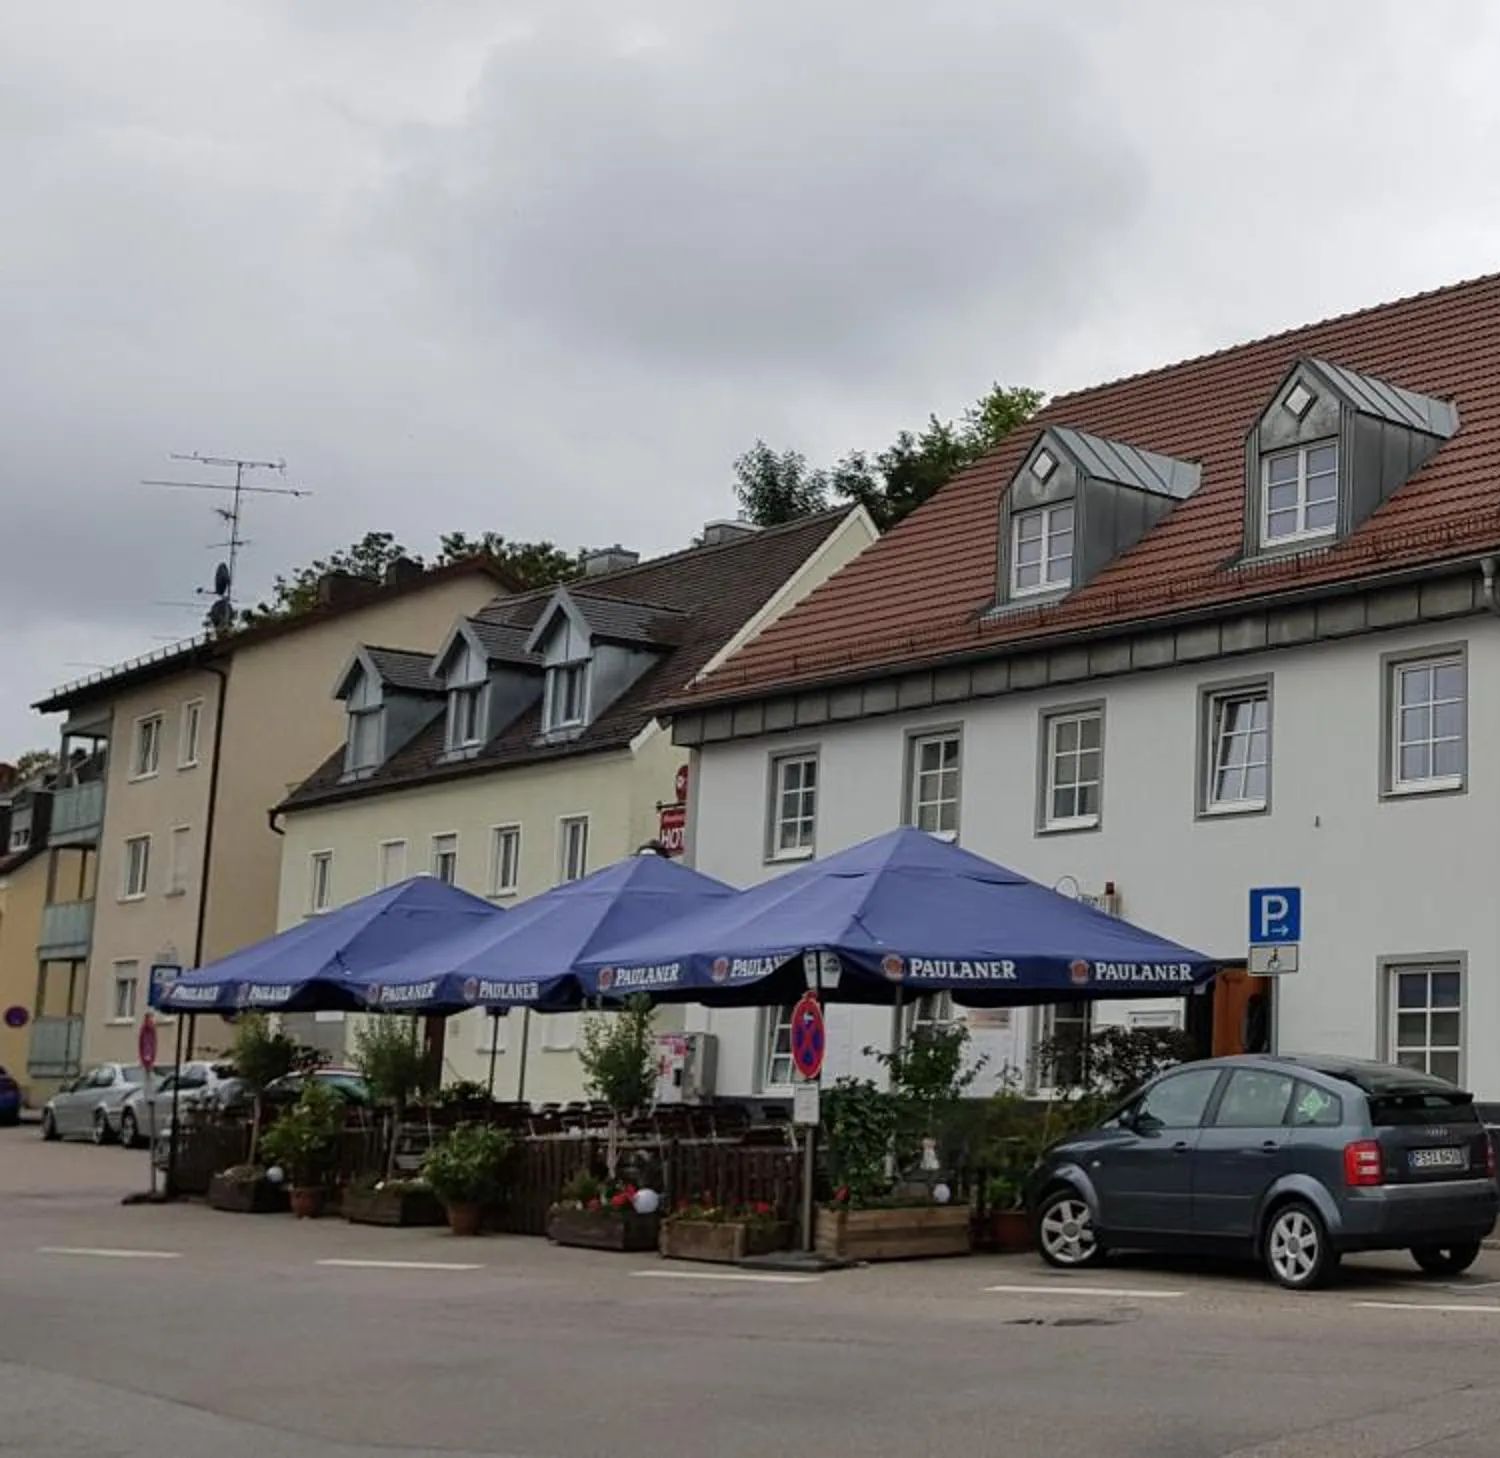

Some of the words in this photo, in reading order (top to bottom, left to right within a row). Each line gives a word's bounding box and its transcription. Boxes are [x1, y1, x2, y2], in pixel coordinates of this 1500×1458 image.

[1261, 895, 1289, 937] P
[614, 964, 681, 986] PAULANER
[909, 958, 1017, 980] PAULANER
[1095, 962, 1194, 982] PAULANER
[479, 981, 540, 1000] PAULANER
